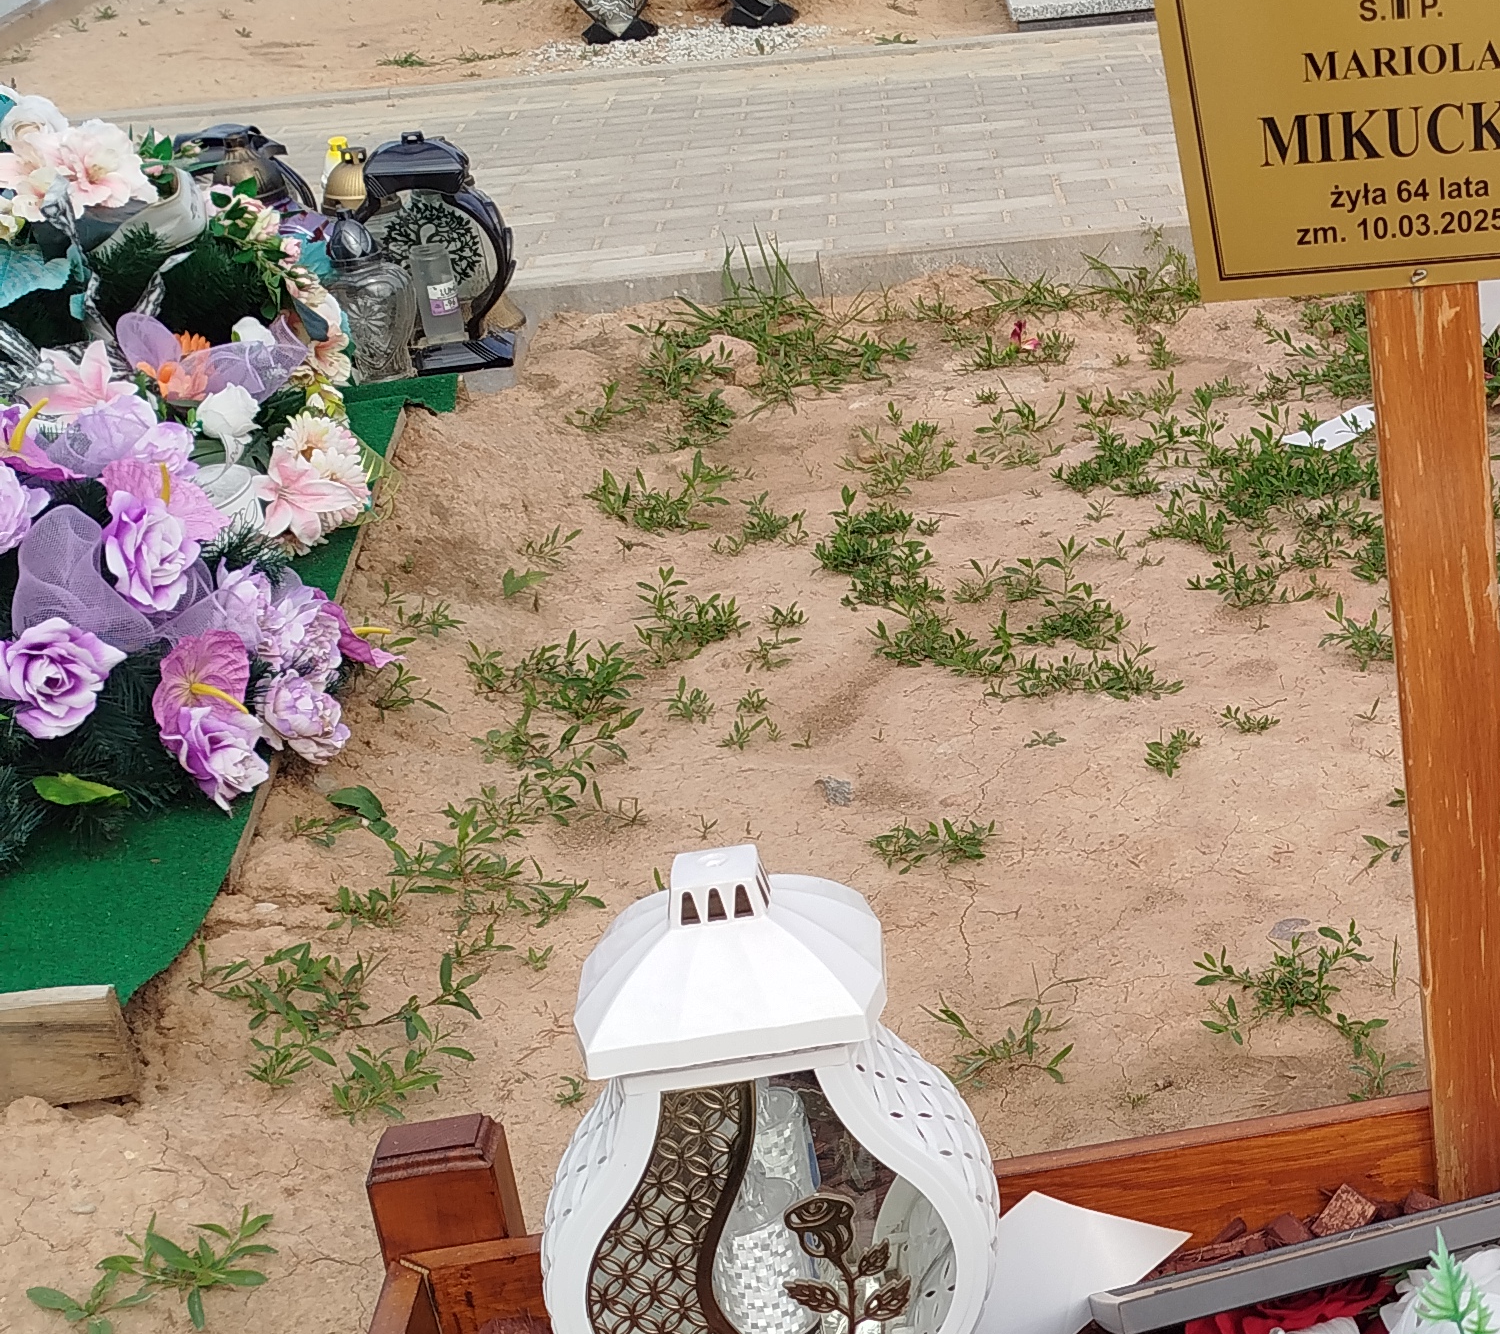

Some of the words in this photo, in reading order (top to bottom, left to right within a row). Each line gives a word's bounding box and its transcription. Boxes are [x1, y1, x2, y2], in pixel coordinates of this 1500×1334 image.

[1330, 183, 1388, 213] żyła
[1396, 179, 1430, 204] 64
[1440, 177, 1490, 201] lata
[1296, 225, 1347, 246] zm.
